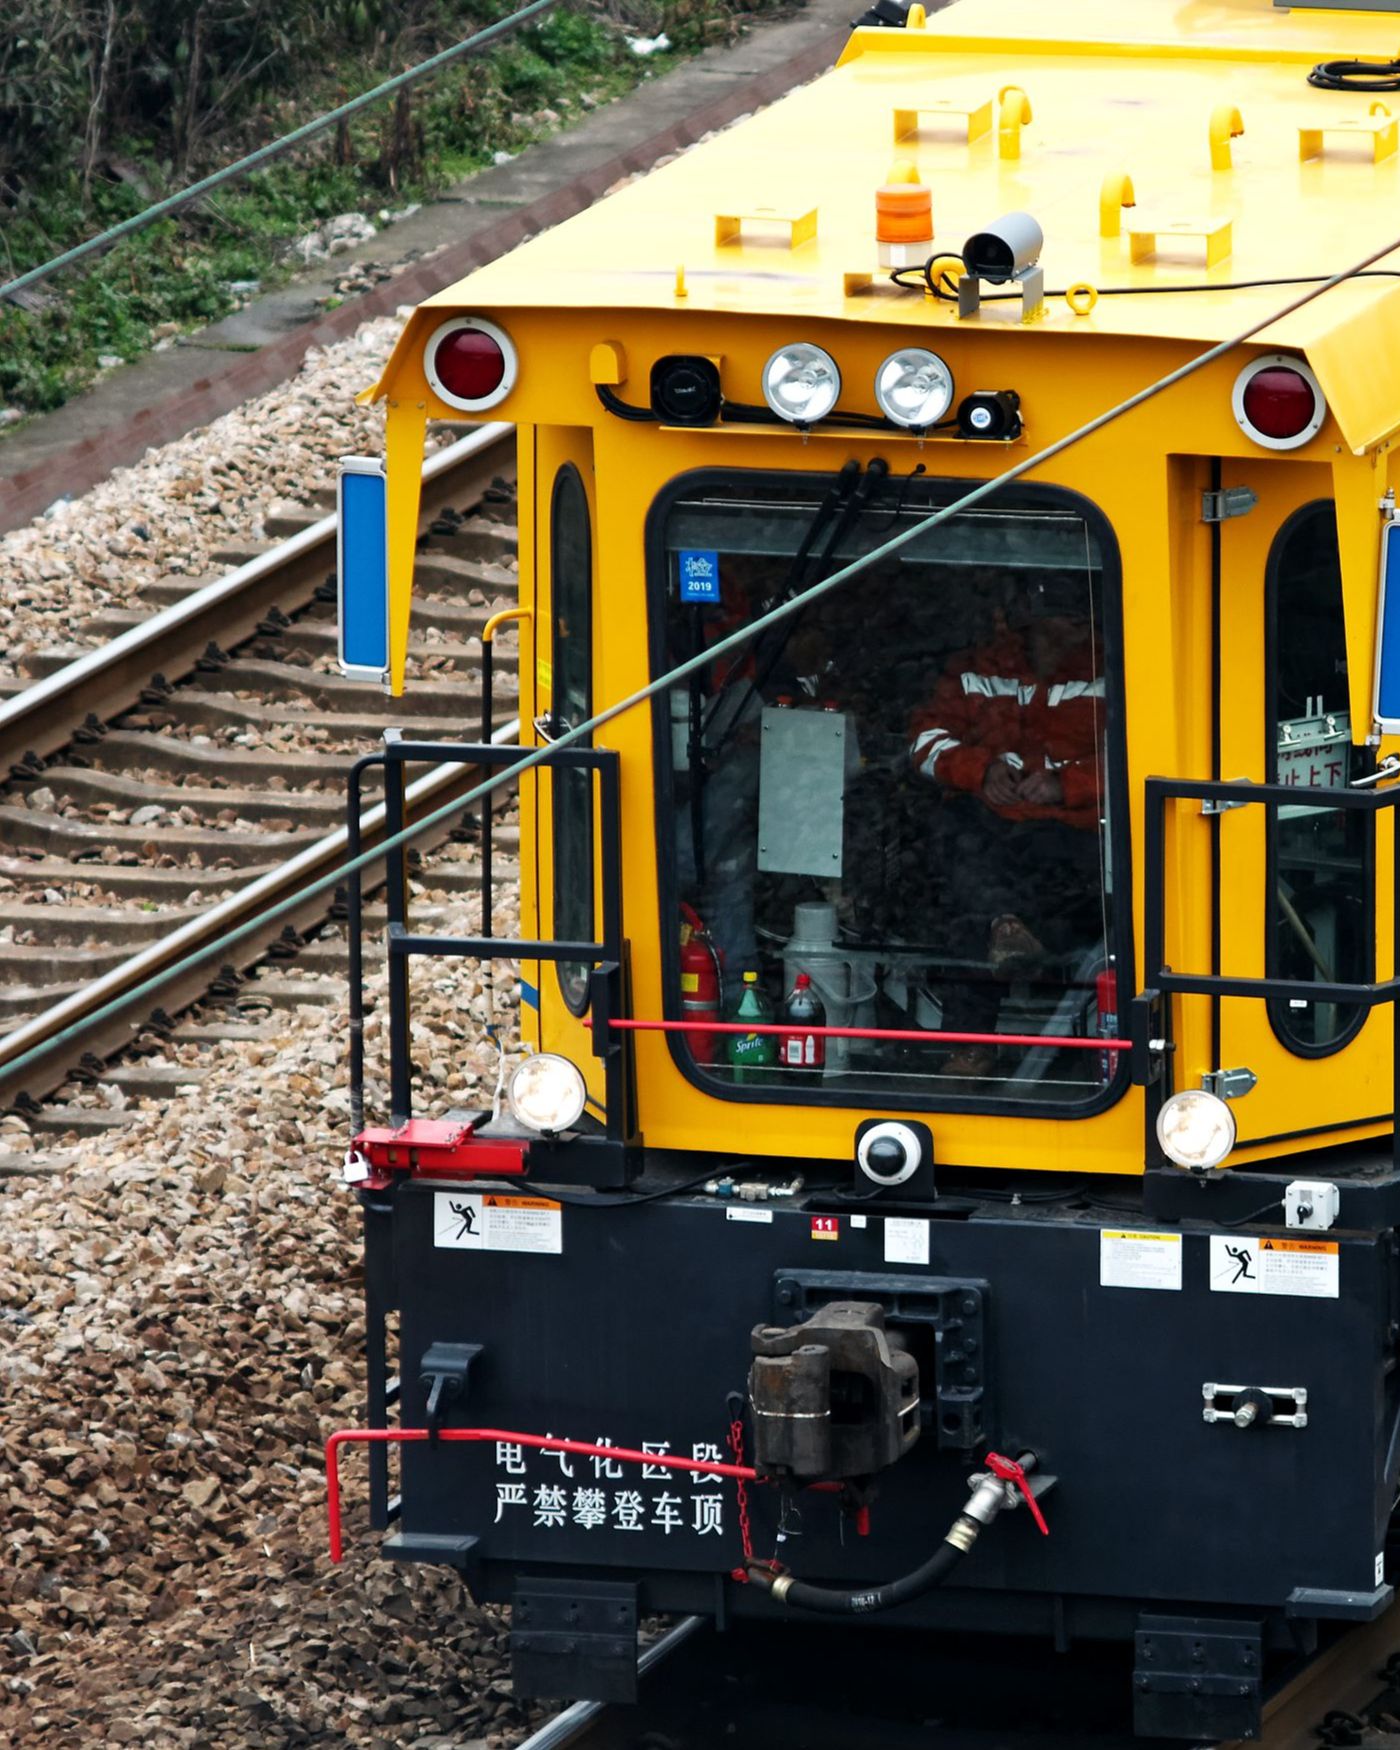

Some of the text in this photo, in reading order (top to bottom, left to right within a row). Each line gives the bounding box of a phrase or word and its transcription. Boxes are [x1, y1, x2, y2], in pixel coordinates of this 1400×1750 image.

[688, 581, 712, 591] 2019
[815, 1219, 833, 1231] 11
[496, 1433, 723, 1484] 电气化区段
[494, 1483, 723, 1535] 严禁攀登车顶
